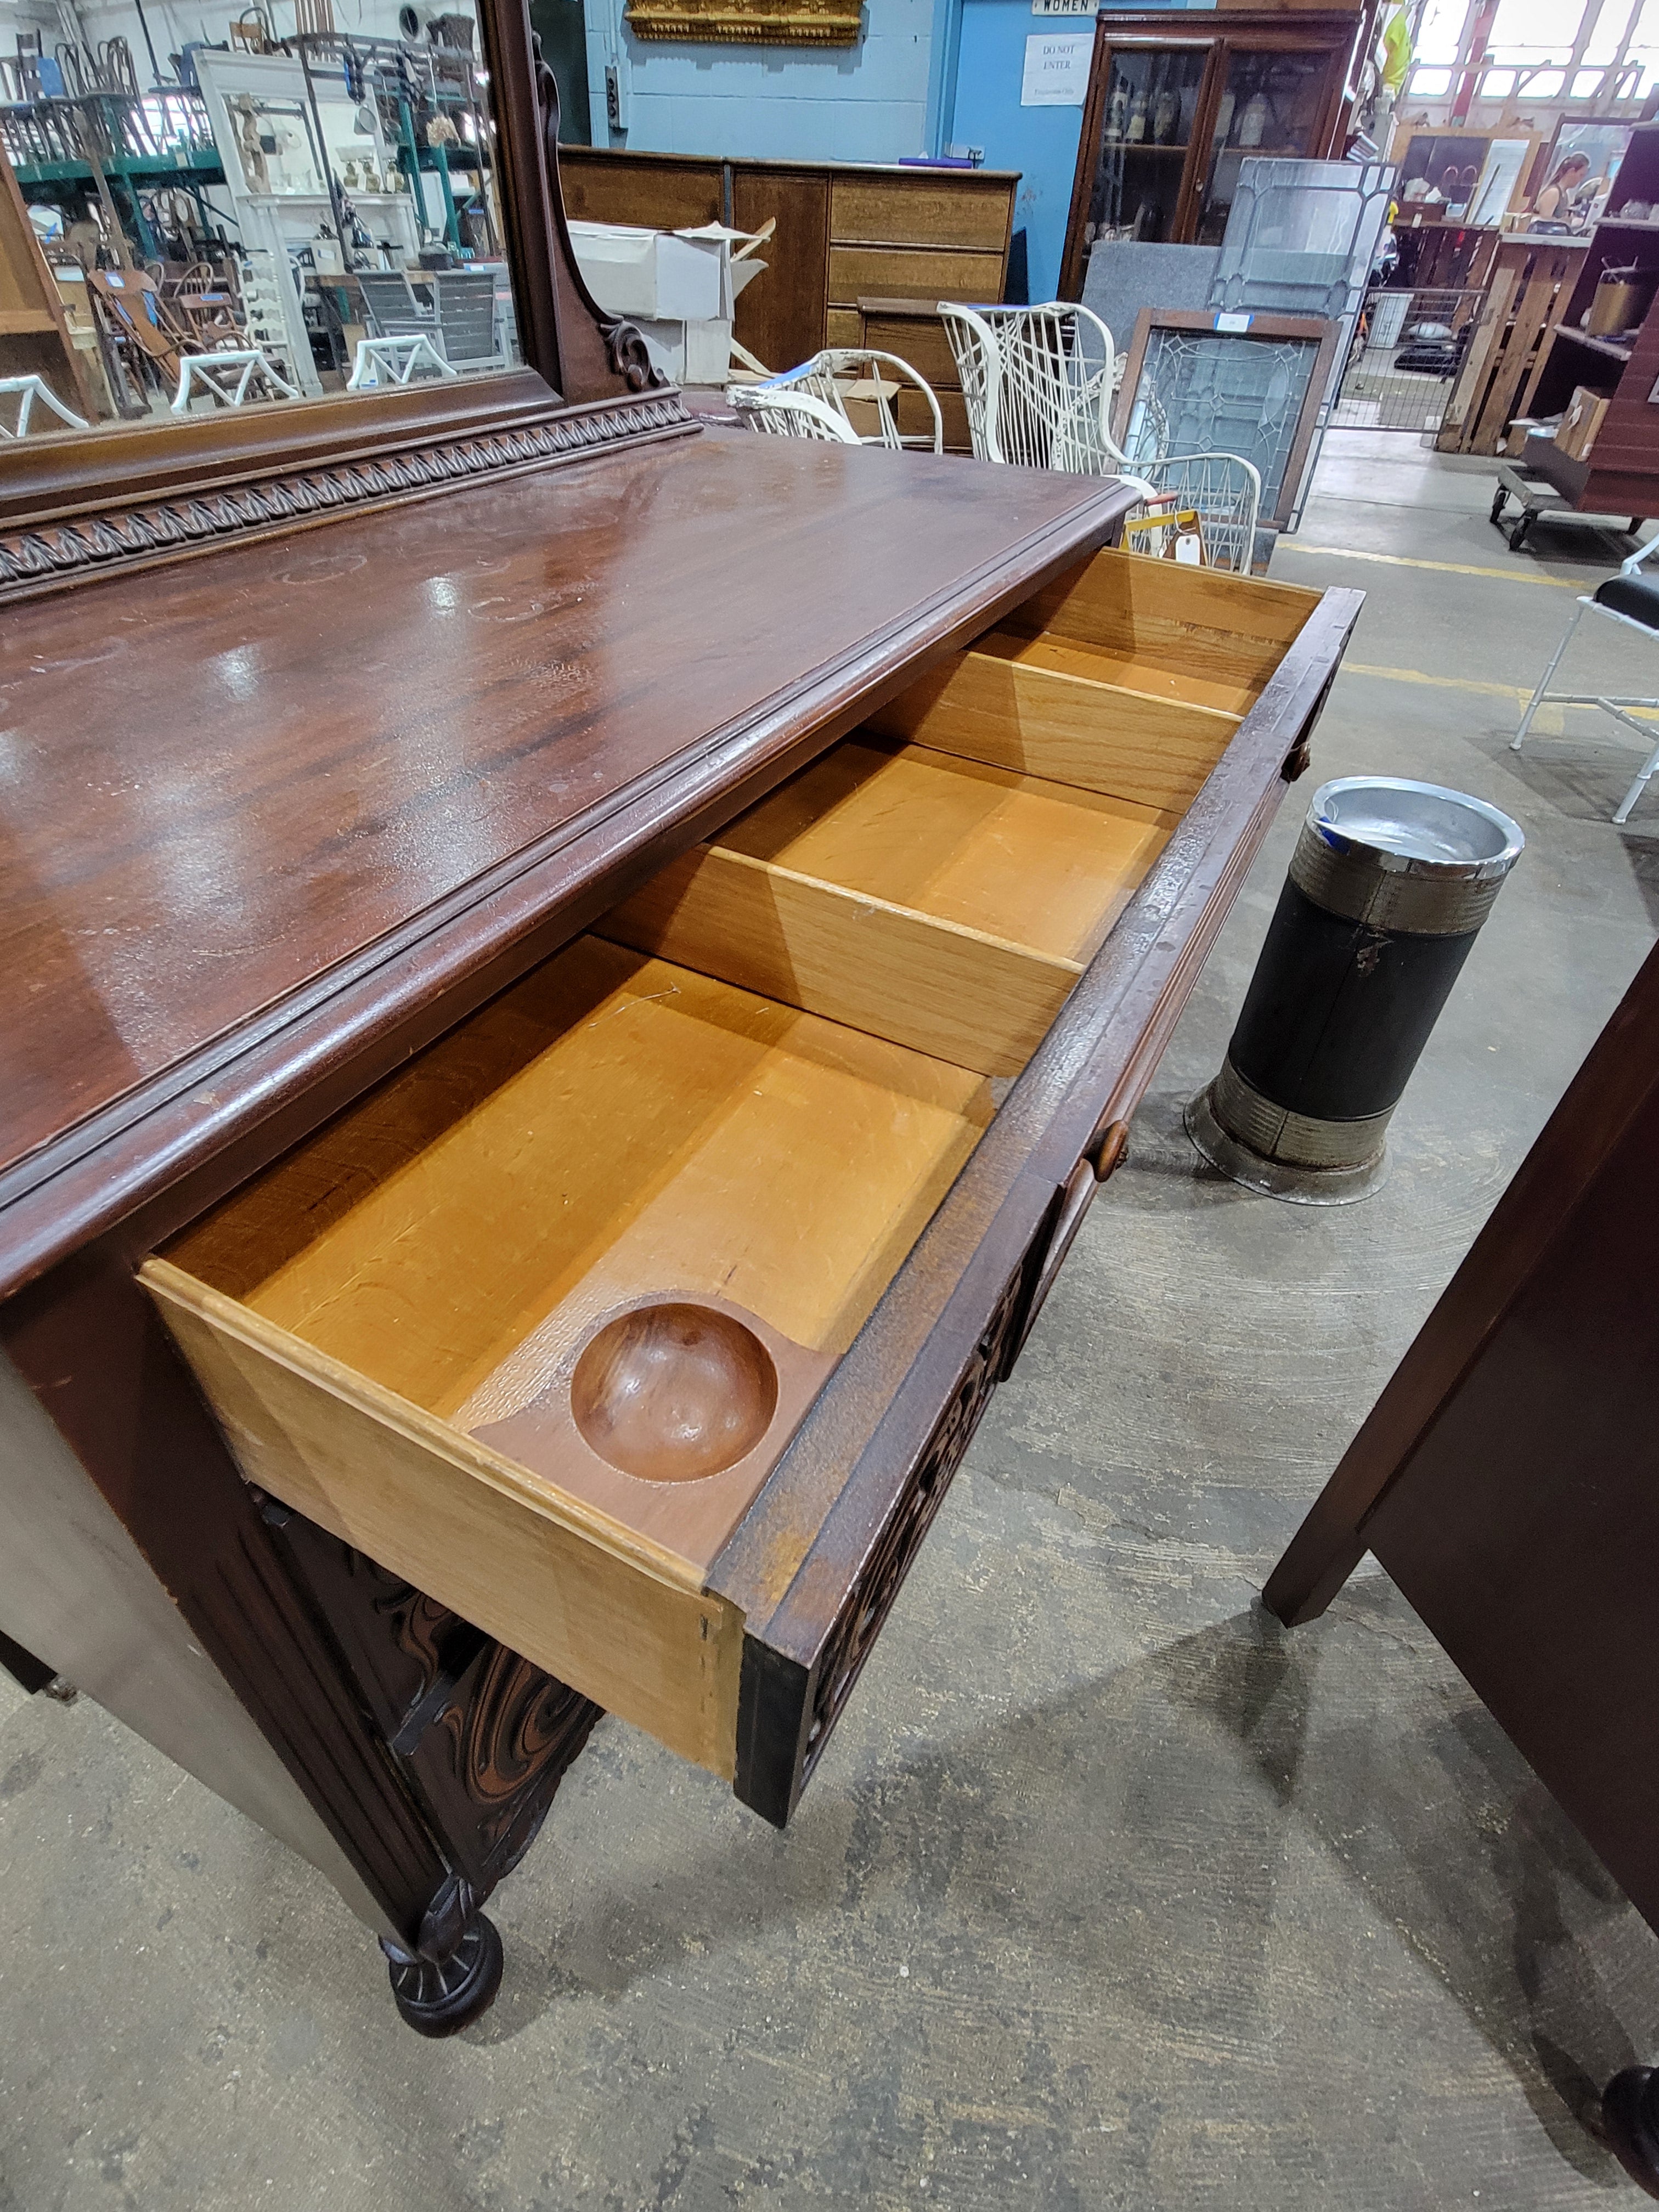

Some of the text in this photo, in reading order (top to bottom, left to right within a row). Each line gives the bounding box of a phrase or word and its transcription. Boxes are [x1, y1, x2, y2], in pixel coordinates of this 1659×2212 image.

[1043, 0, 1088, 11] WOMEN
[1043, 45, 1075, 54] DO NOT
[1043, 61, 1071, 70] ENTER
